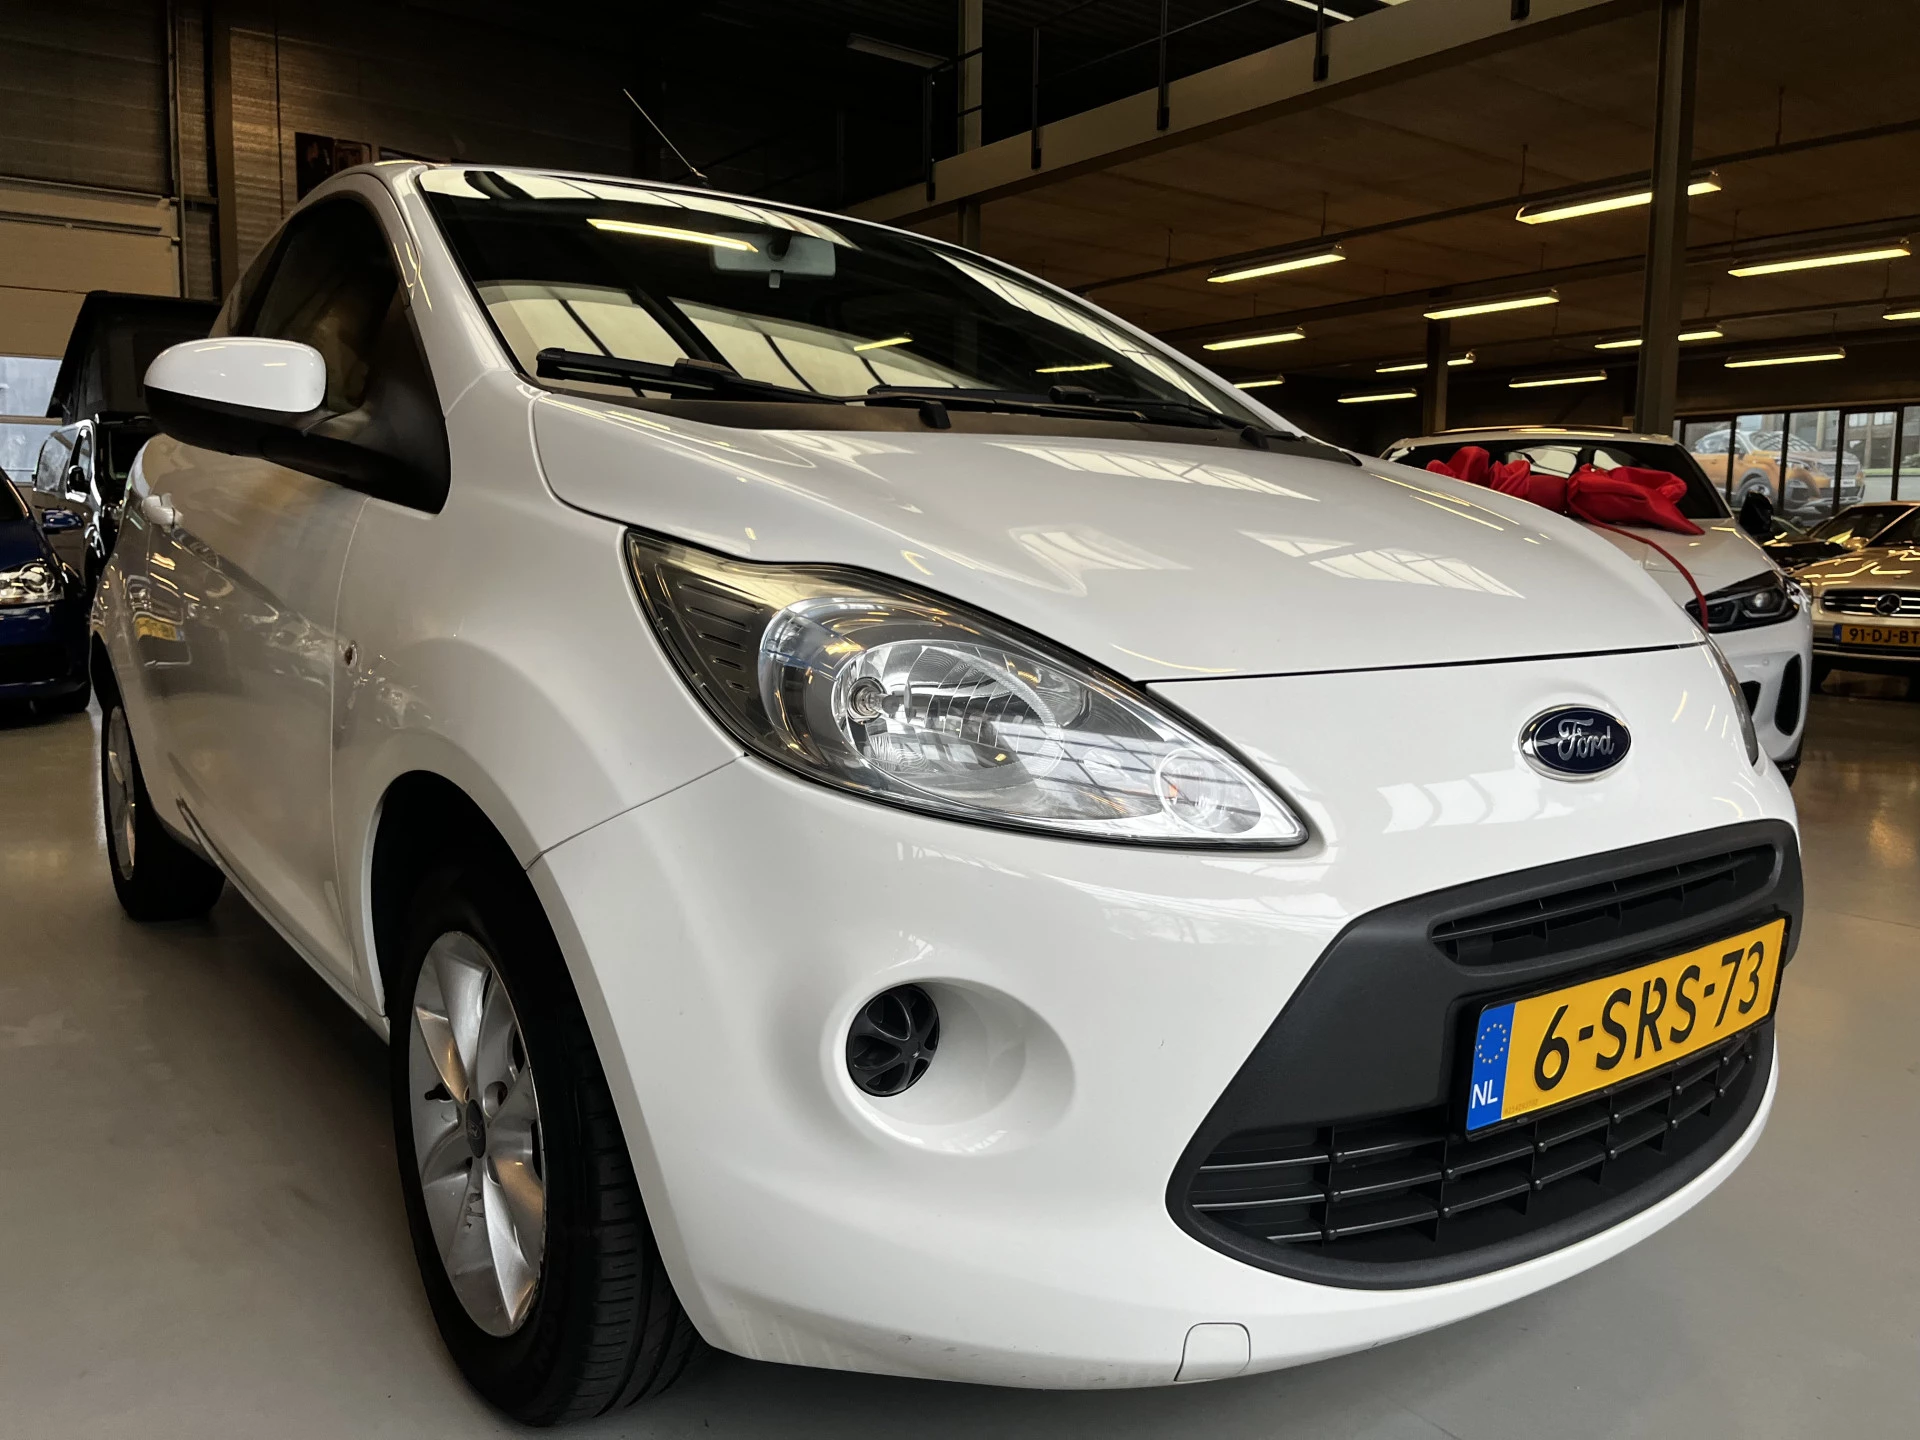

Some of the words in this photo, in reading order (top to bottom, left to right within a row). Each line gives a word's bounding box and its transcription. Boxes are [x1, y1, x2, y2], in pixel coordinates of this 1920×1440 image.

[1849, 628, 1920, 643] 91-DJ-BT
[1558, 718, 1614, 761] Ford
[1533, 941, 1764, 1091] 6-SRS-73
[1471, 1080, 1498, 1109] NL
